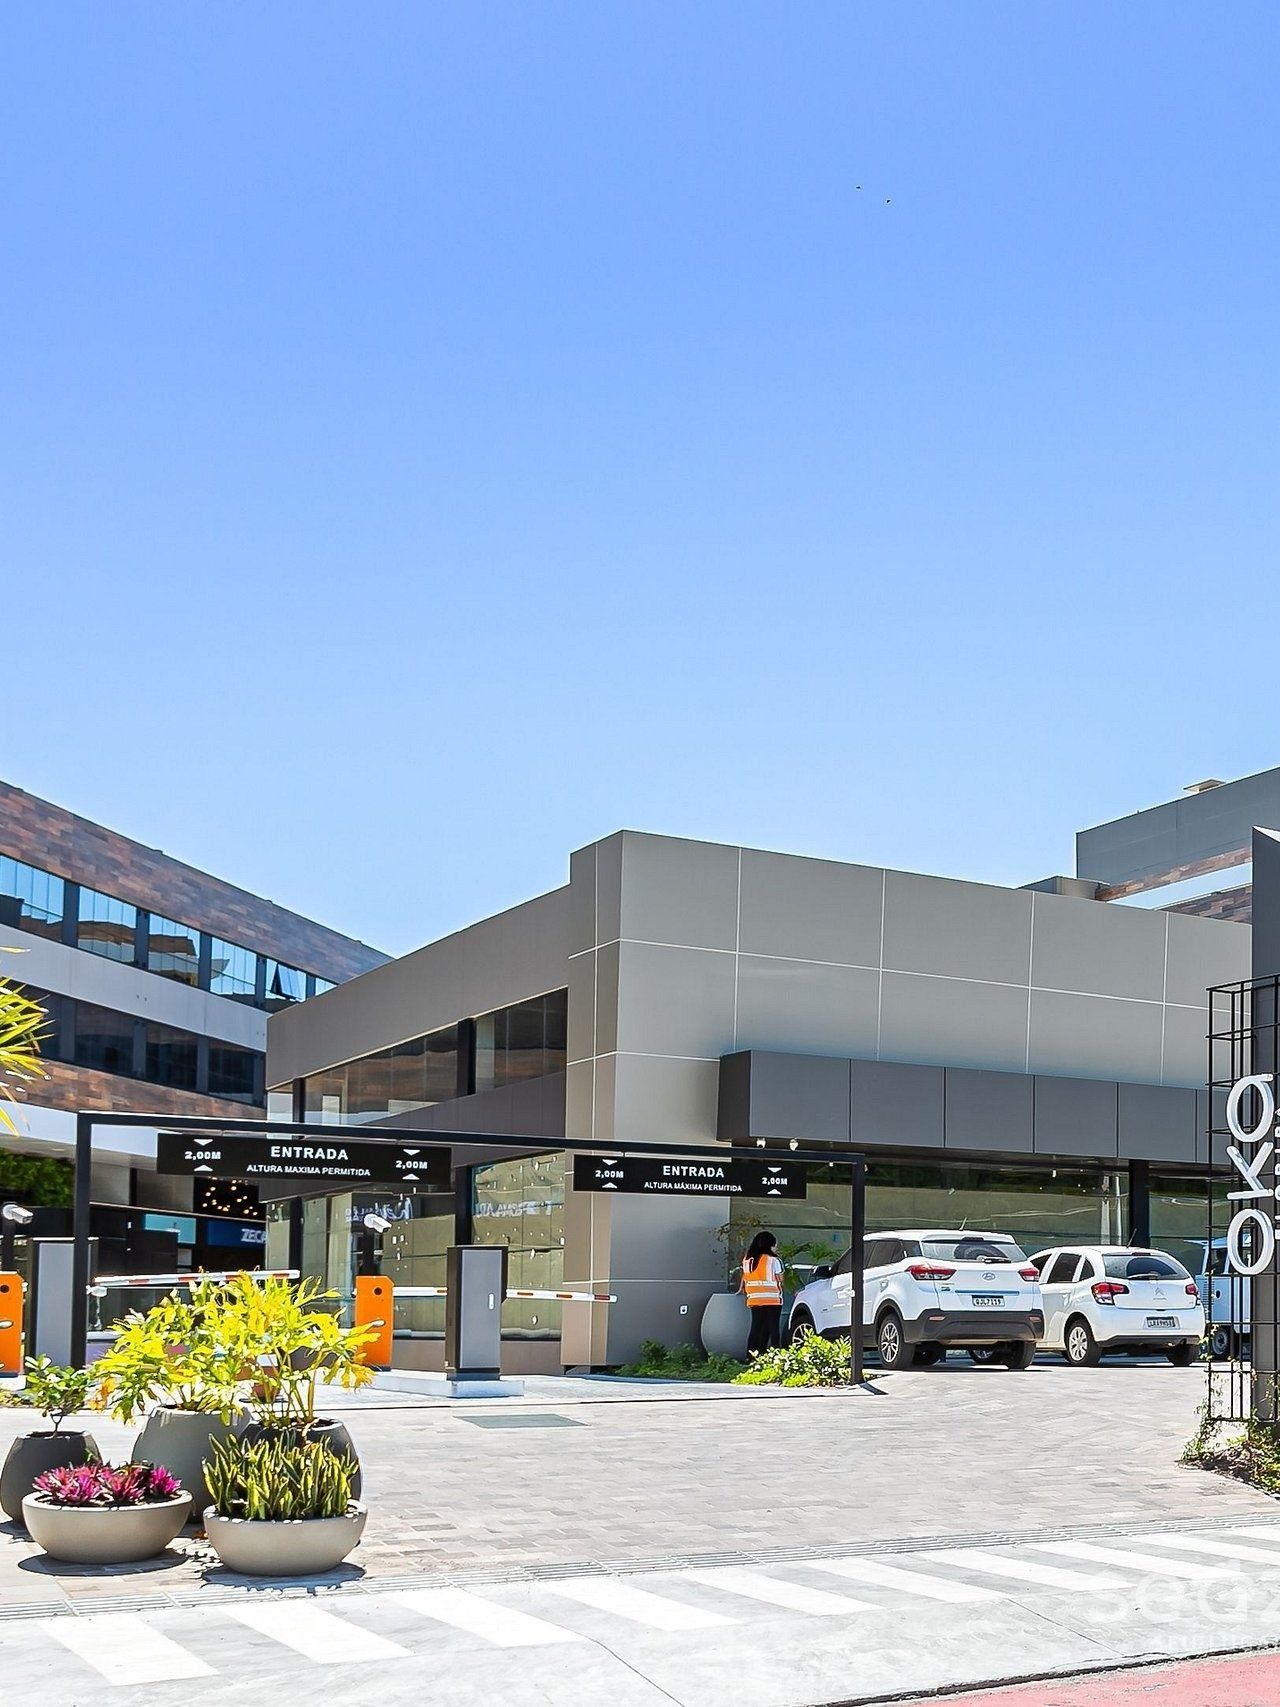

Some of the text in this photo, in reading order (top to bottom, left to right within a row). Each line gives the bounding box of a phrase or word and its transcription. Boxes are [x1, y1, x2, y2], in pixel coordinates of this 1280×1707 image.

[184, 1150, 222, 1161] 2,00M
[270, 1145, 349, 1161] ENTRADA
[246, 1164, 284, 1174] ALTURA
[322, 1167, 371, 1177] PERMITIDA
[395, 1160, 428, 1170] 2,00M
[594, 1170, 625, 1179] 2,00M
[662, 1165, 725, 1178] ENTRADA
[643, 1181, 673, 1190] ALTURA
[703, 1183, 743, 1192] PERMITIDA
[761, 1177, 788, 1186] 2,00M
